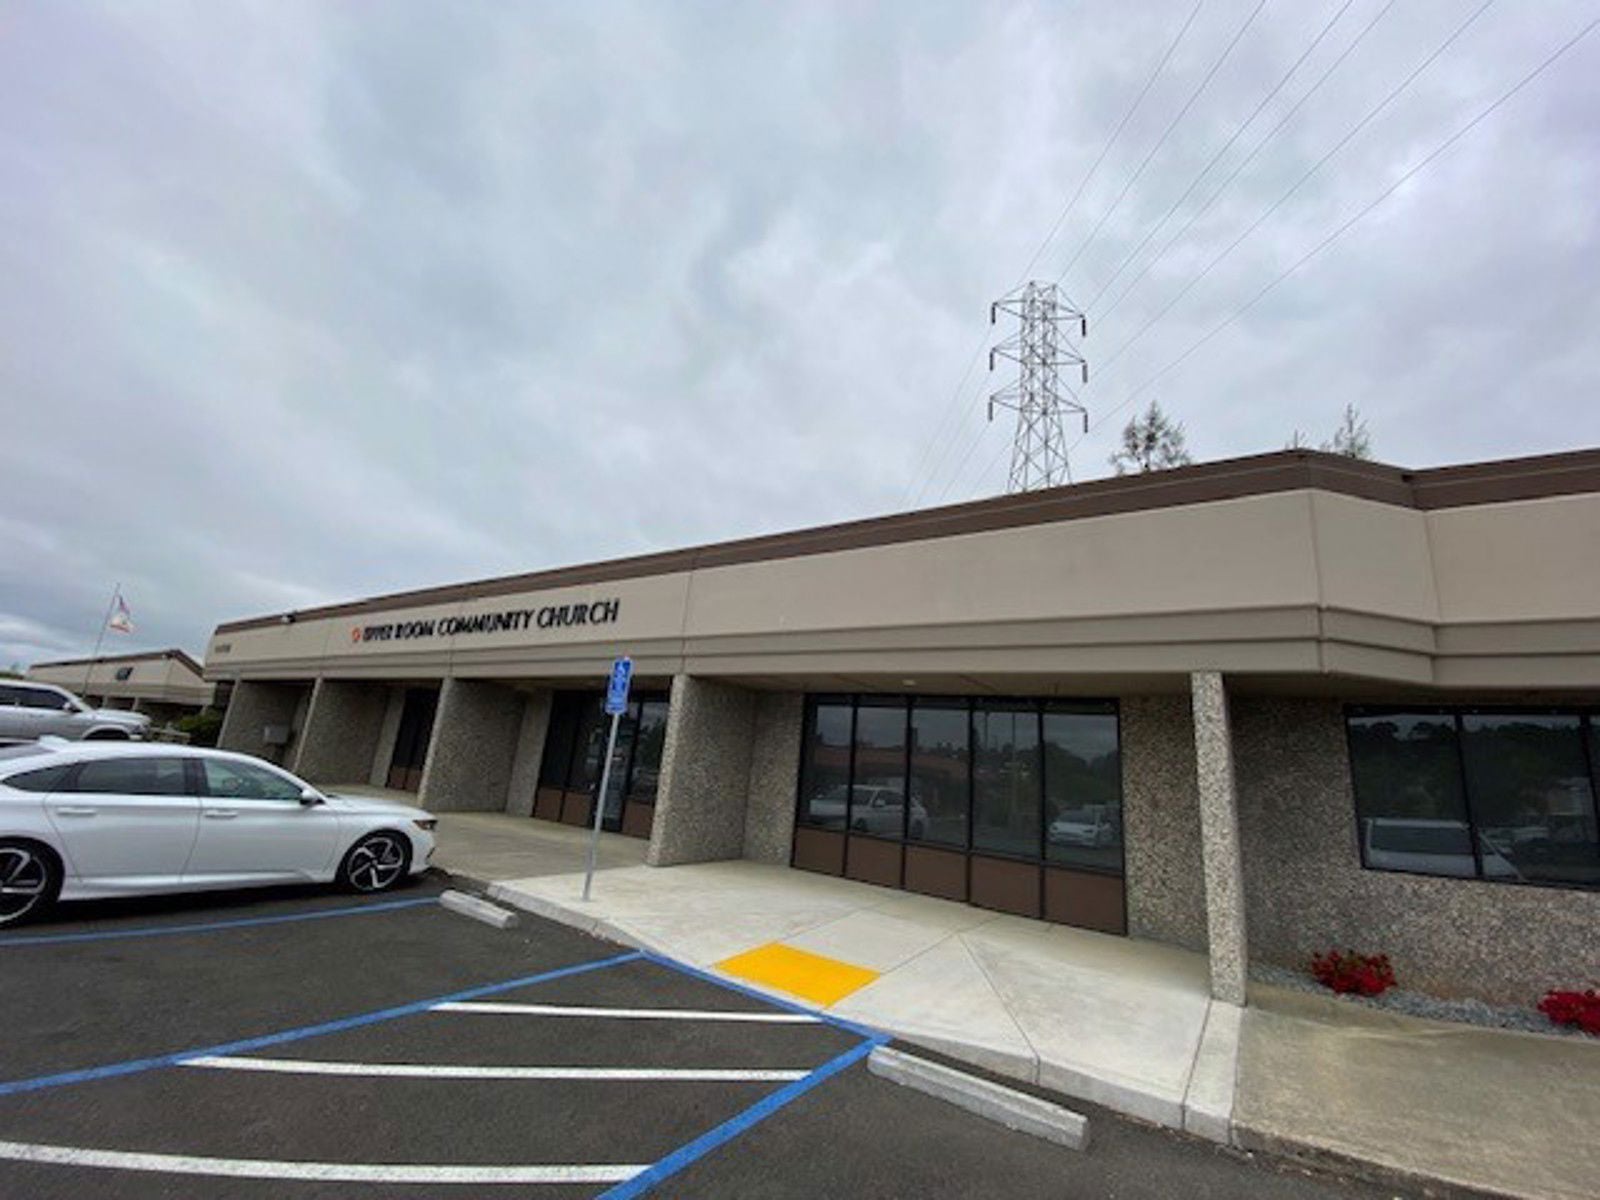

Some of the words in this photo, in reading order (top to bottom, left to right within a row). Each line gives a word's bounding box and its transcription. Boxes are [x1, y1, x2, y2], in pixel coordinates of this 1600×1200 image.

[395, 619, 435, 639] ROOM
[437, 609, 535, 636] COMMUNITY
[537, 598, 620, 629] CHURCH
